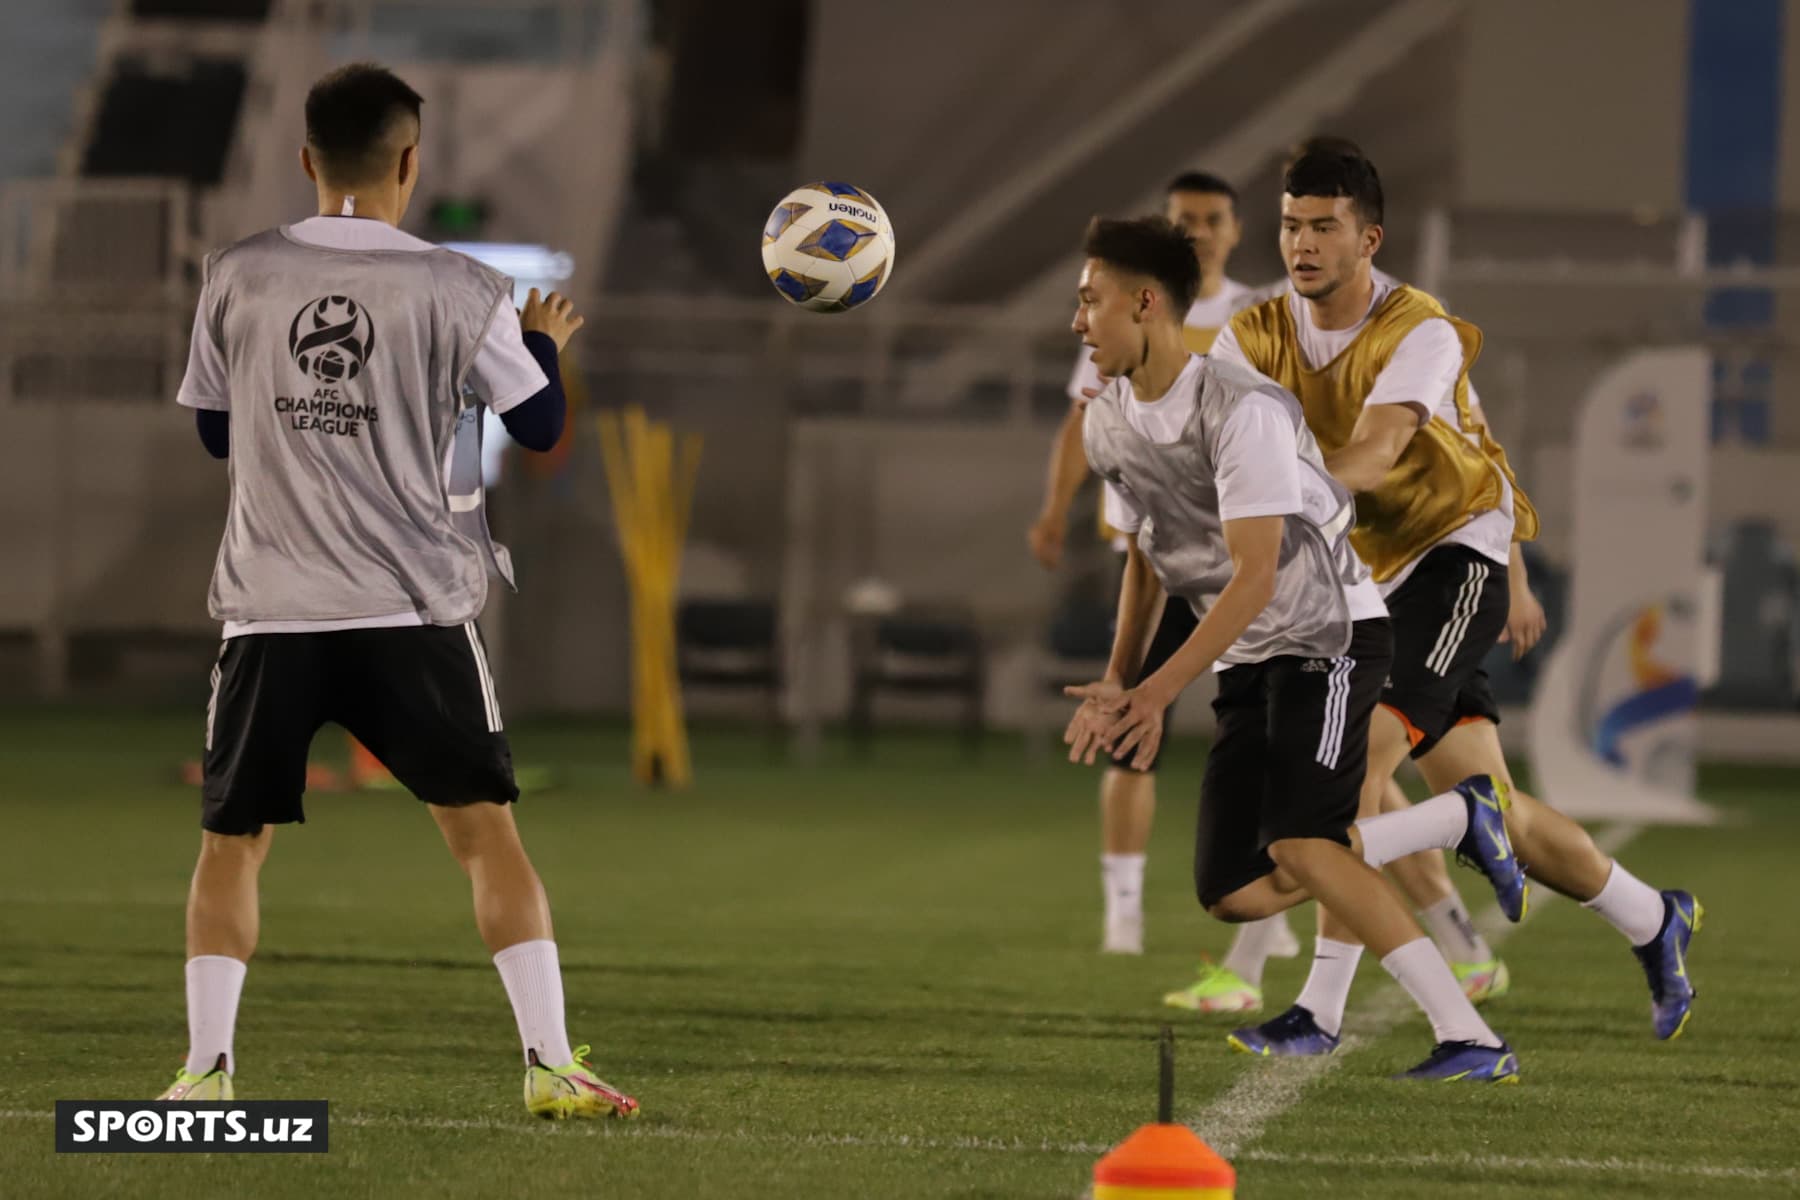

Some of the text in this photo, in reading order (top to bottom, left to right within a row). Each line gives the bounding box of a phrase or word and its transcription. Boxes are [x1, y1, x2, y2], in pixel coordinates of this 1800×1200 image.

[829, 202, 877, 223] molten
[313, 388, 339, 400] AFC
[274, 397, 379, 422] CHAMPIONS
[291, 415, 359, 437] LEAGUE
